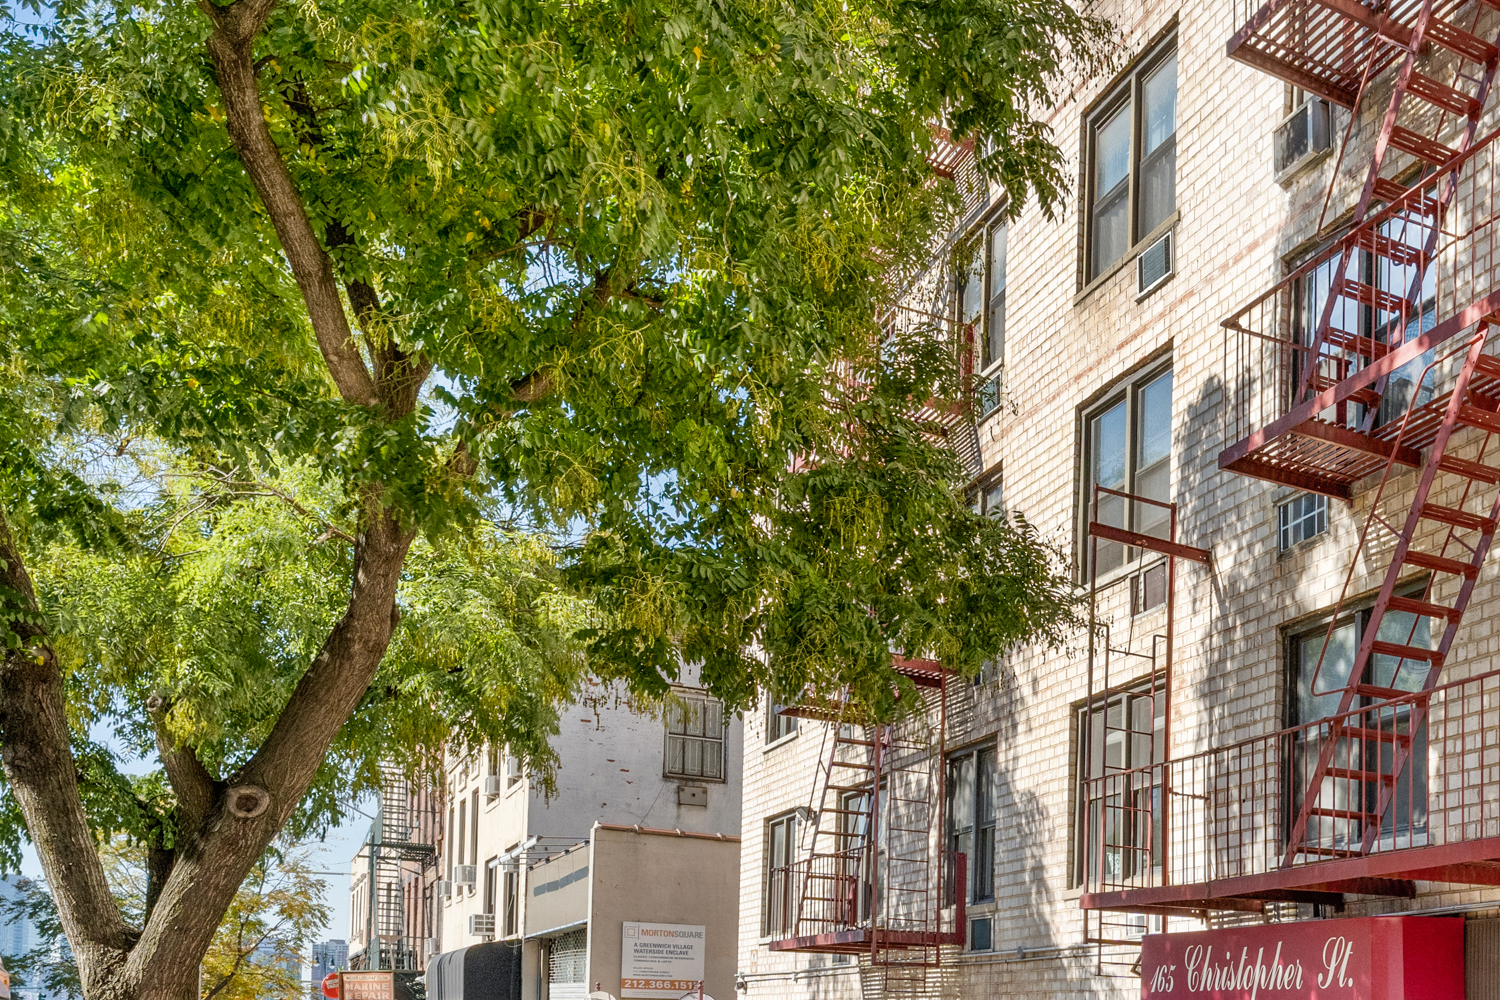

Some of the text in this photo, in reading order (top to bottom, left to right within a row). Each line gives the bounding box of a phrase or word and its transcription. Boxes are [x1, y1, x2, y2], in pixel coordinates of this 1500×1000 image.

[641, 929, 703, 938] MORTONSQUARE
[1150, 965, 1176, 993] 165
[1317, 936, 1354, 989] St.
[345, 982, 390, 991] MARINE
[345, 992, 390, 1000] REPAIR
